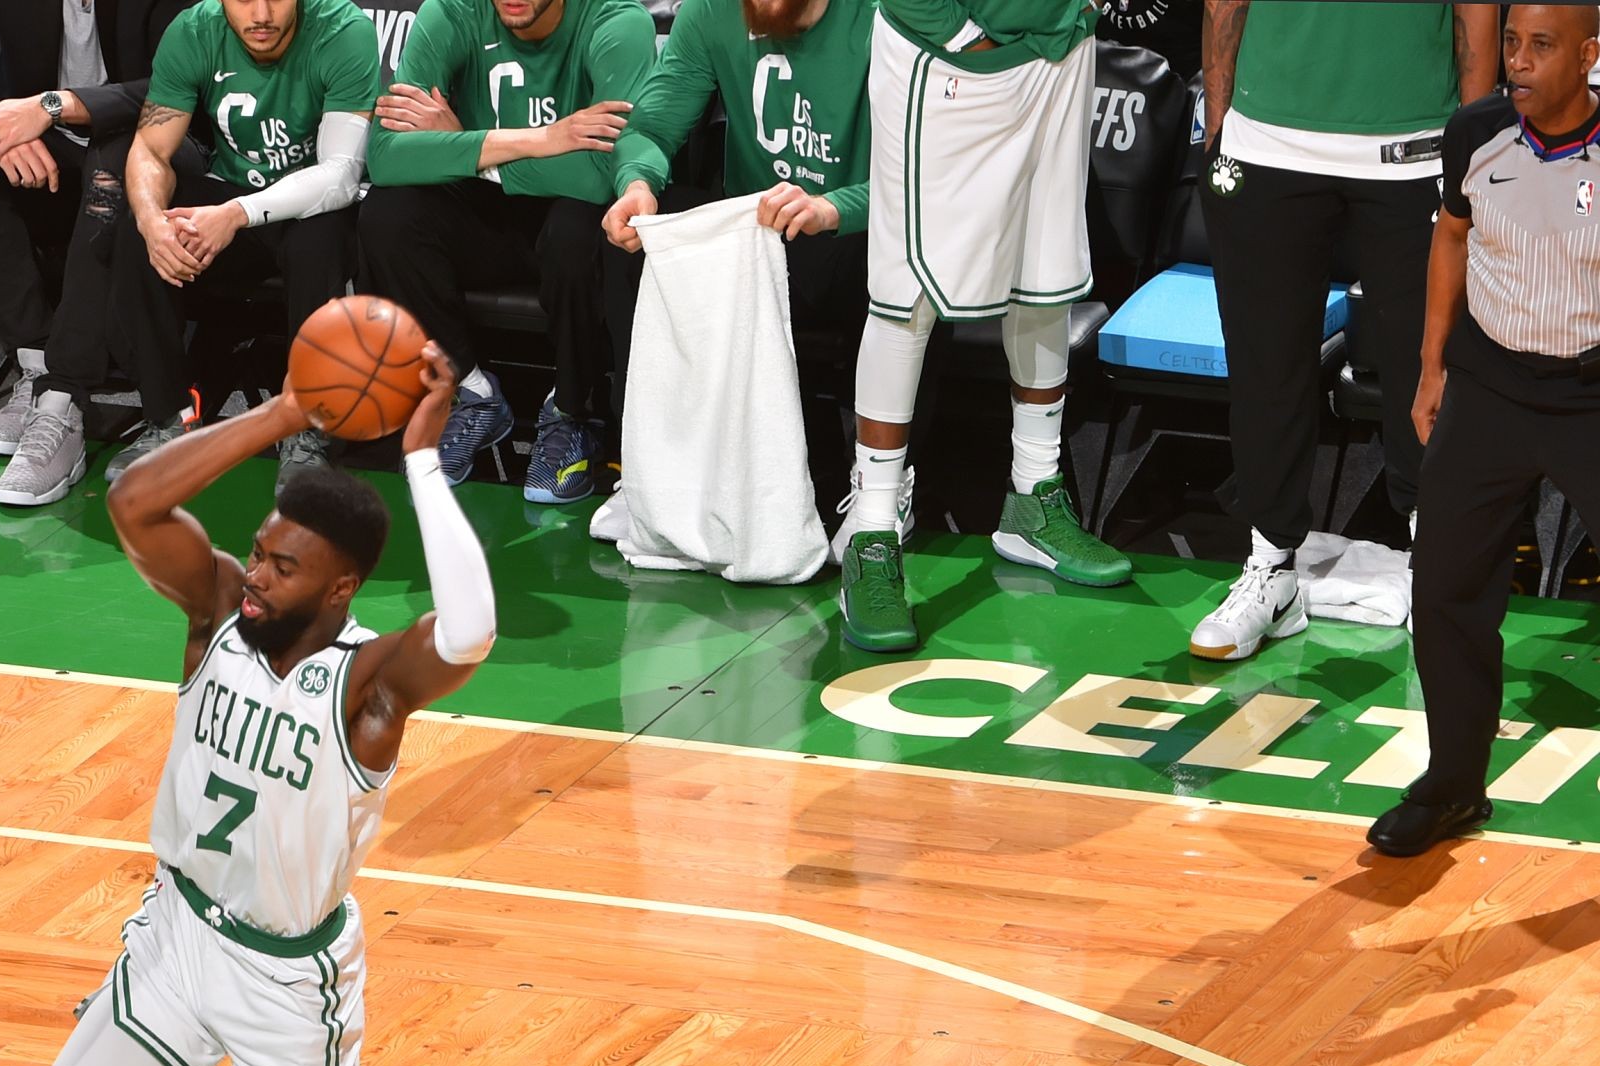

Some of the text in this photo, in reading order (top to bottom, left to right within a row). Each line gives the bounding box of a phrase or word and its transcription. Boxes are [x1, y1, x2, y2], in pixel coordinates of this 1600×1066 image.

[528, 96, 557, 128] US
[753, 53, 792, 154] C
[793, 92, 812, 127] US
[260, 118, 290, 148] US
[1212, 155, 1243, 179] CELTICS
[1158, 350, 1227, 372] CELTICS
[194, 679, 321, 791] CELTICS
[820, 658, 1600, 804] CELTI
[195, 771, 258, 857] 7
